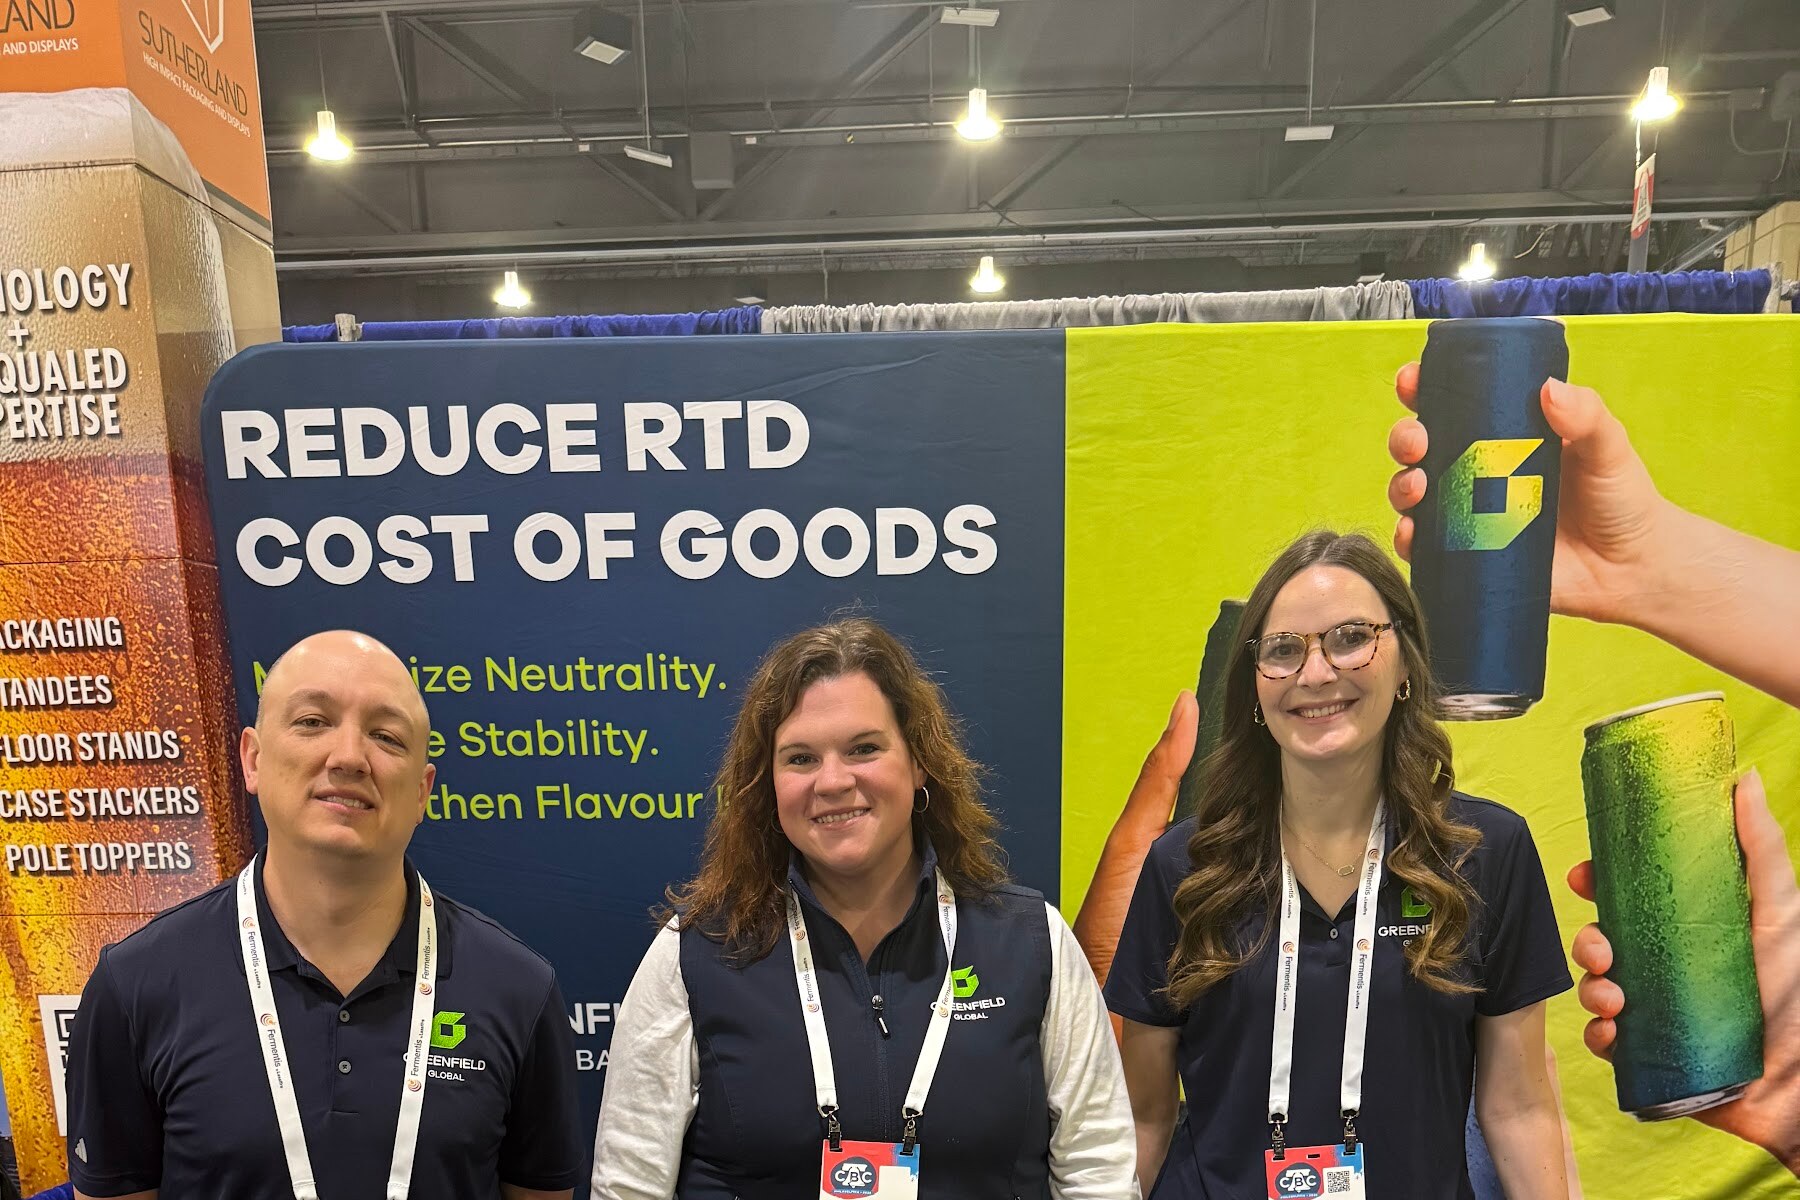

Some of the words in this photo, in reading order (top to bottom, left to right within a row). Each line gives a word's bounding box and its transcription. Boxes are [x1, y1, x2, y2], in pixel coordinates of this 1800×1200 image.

[2, 40, 27, 56] AND
[29, 37, 79, 53] DISPLAYS
[139, 10, 248, 117] SUTHERLAND
[221, 403, 601, 479] REDUCE
[623, 399, 810, 472] RTD
[236, 514, 489, 586] COST
[514, 511, 637, 583] OF
[660, 504, 998, 580] GOODS
[0, 615, 122, 650] CKAGING
[487, 652, 727, 698] Neutrality.
[0, 733, 72, 763] LOOR
[79, 731, 181, 761] STANDS
[460, 718, 659, 764] Stability.
[0, 789, 65, 818] CASE
[68, 785, 199, 818] STACKERS
[538, 783, 703, 820] Flavour
[6, 842, 69, 873] POLE
[76, 839, 192, 871] TOPPERS
[1364, 862, 1377, 896] Fermentis
[248, 931, 259, 968] Fermentis
[422, 946, 430, 980] Fermentis
[1284, 956, 1293, 991] Fermentis
[1356, 954, 1368, 989] Fermentis
[954, 1012, 988, 1021] GLOBAL
[267, 1029, 281, 1068] Fermentis
[411, 1039, 423, 1076] Fermentis
[428, 1069, 465, 1082] GLOBAL
[834, 1170, 873, 1184] CBC
[1279, 1174, 1317, 1188] CBC
